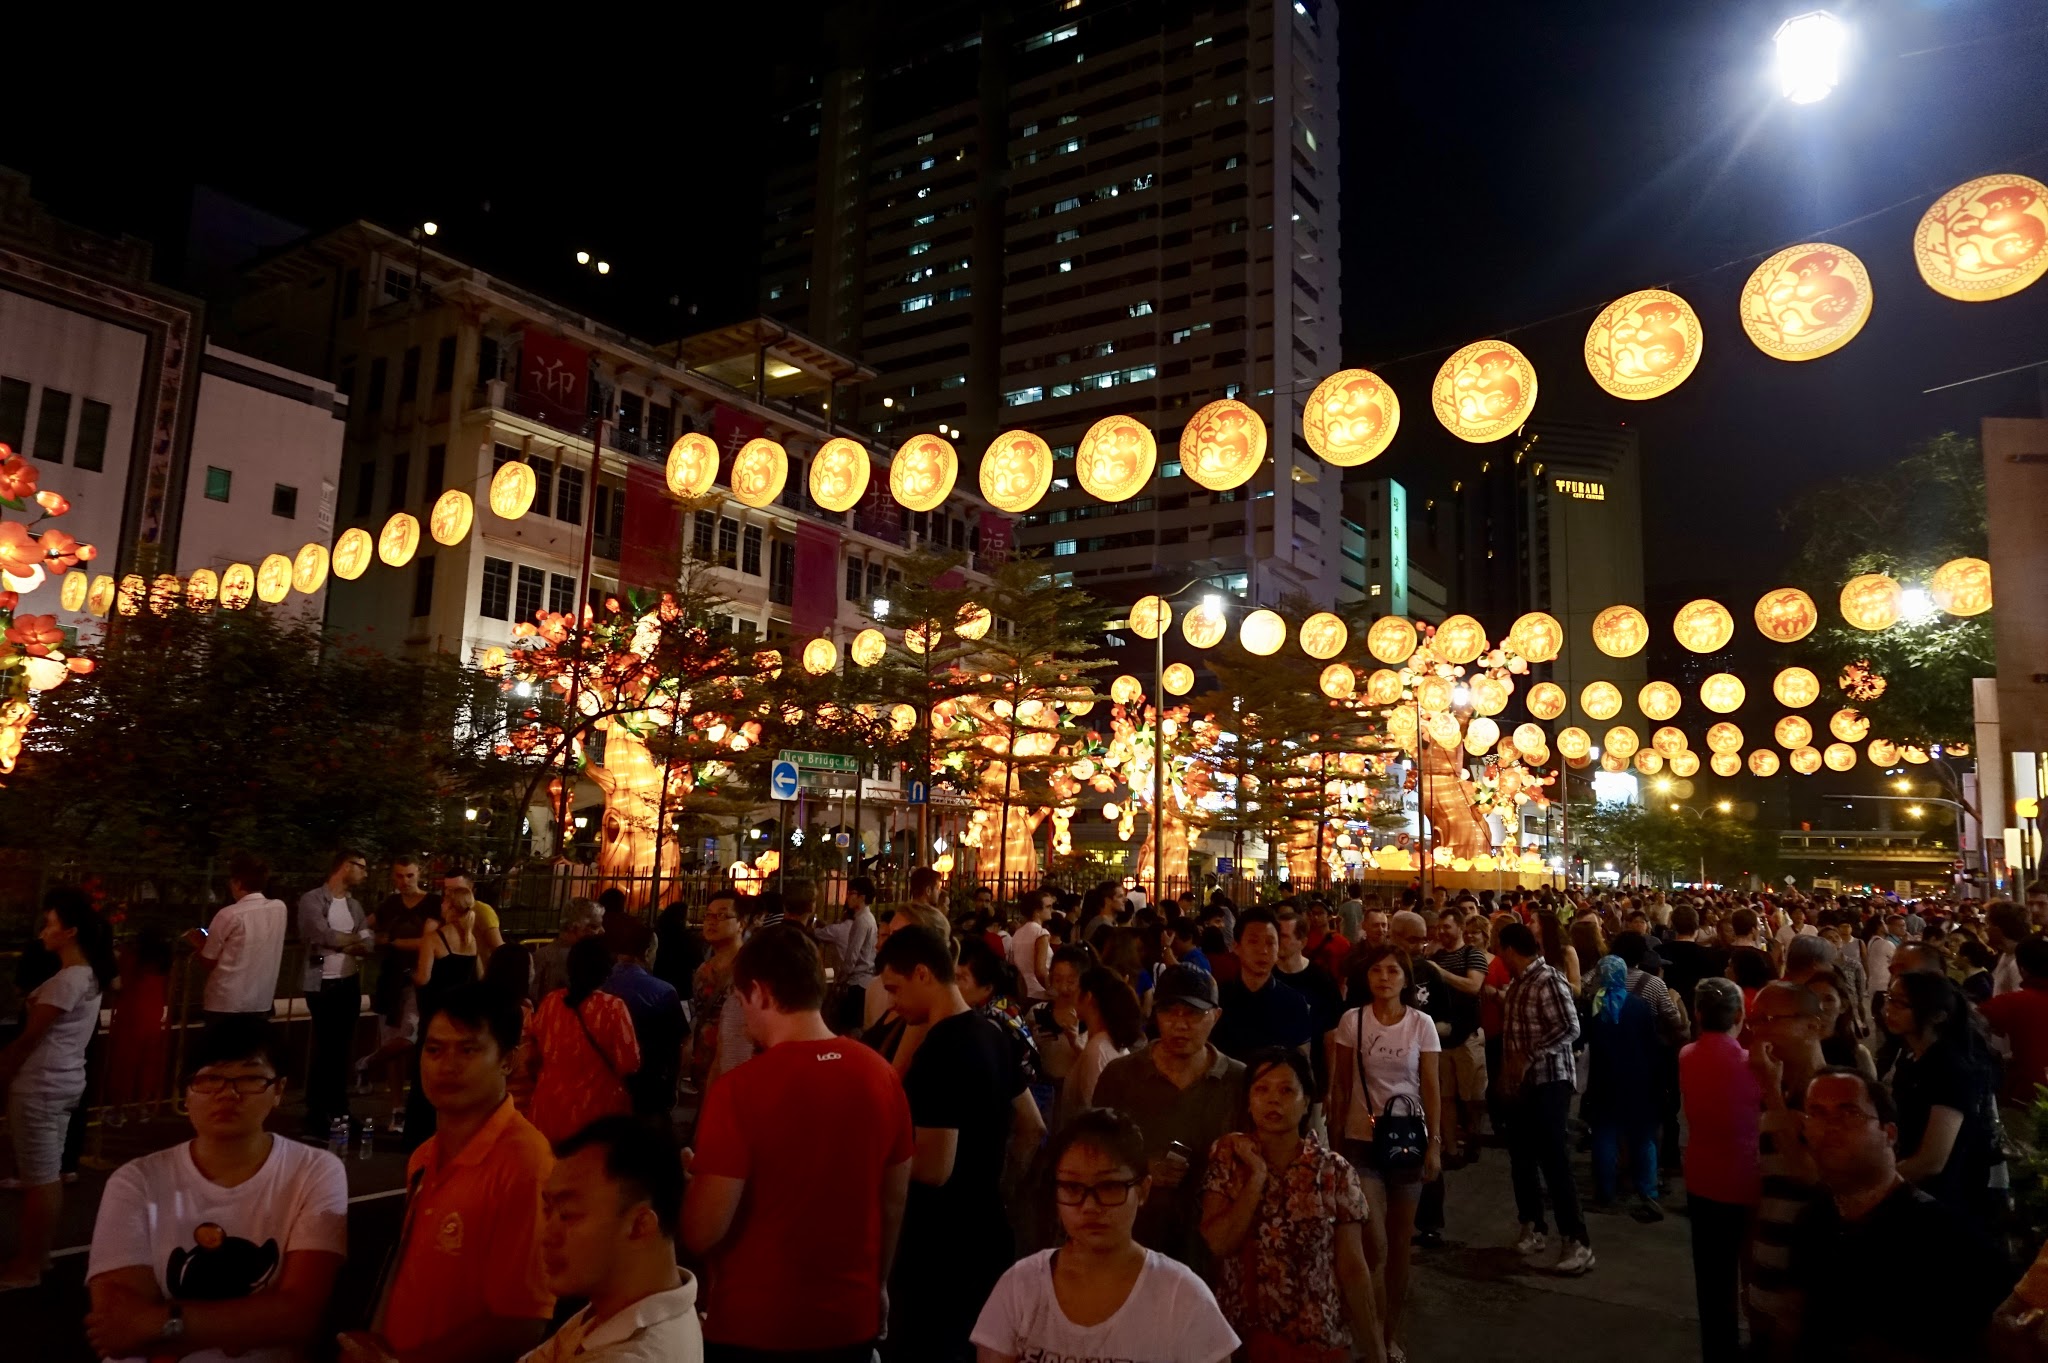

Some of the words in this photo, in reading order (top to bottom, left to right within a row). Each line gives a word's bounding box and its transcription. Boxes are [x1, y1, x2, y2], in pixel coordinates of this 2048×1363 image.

[528, 354, 581, 410] 迎
[864, 479, 899, 525] 接
[1565, 480, 1604, 495] FURAMA
[981, 527, 1007, 563] 福
[784, 751, 804, 763] New
[808, 753, 841, 768] Bridge
[844, 757, 855, 767] Rd
